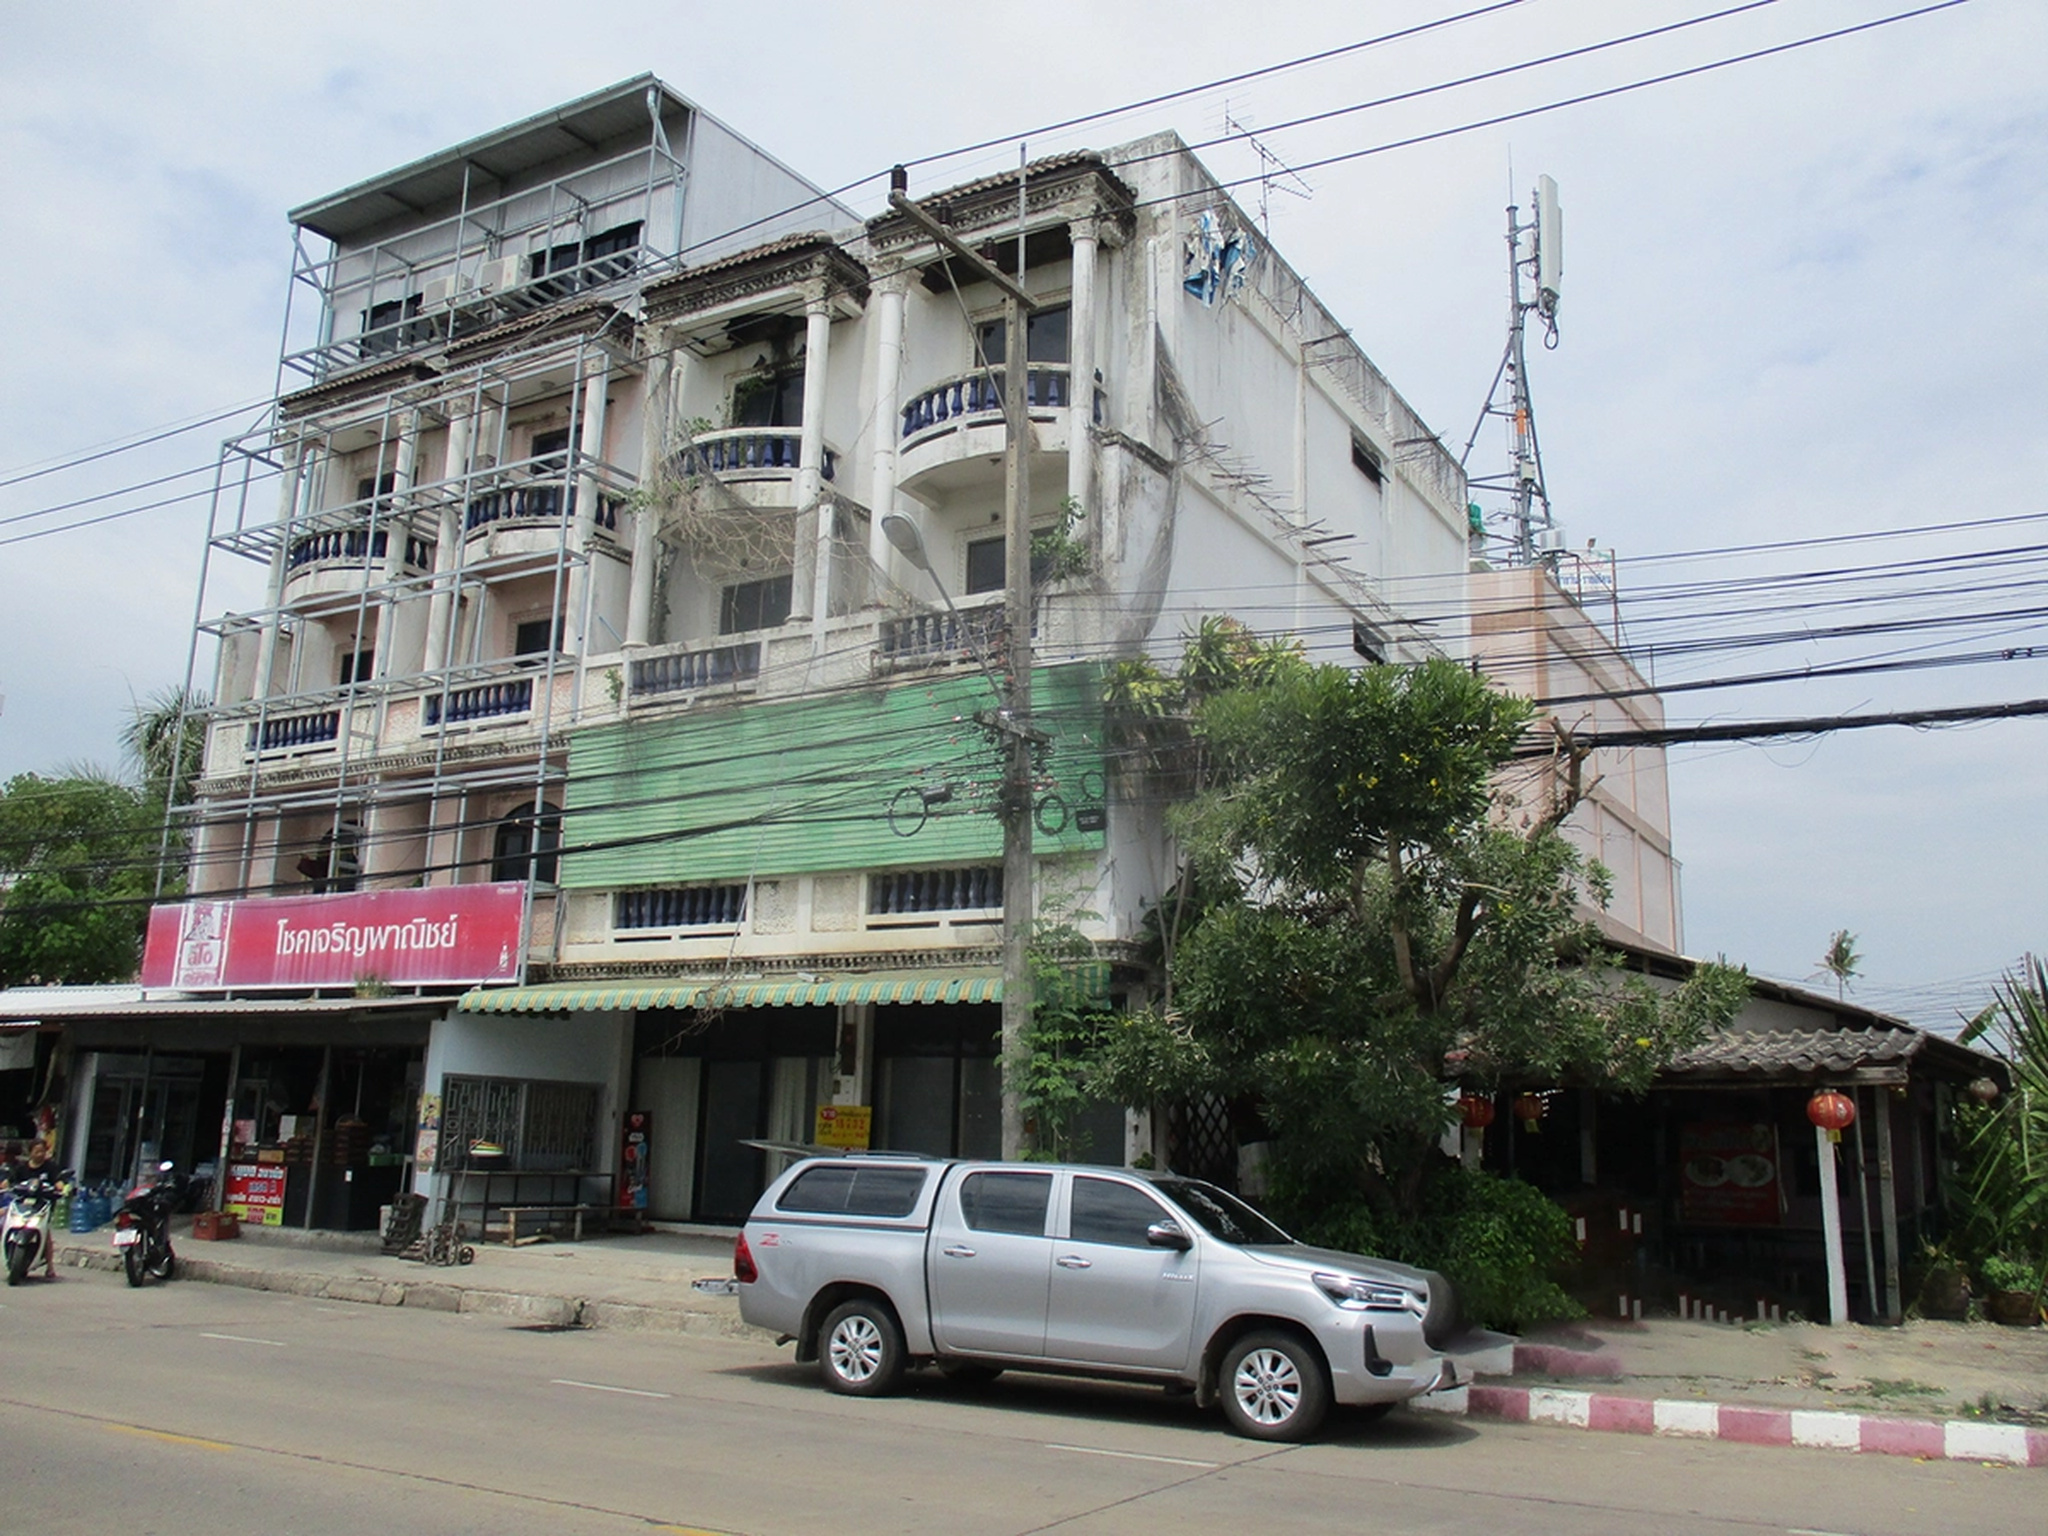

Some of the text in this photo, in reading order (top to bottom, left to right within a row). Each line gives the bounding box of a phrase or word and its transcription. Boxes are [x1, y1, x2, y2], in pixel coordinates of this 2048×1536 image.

[276, 914, 458, 956] โชคเจริญพาณิชย์
